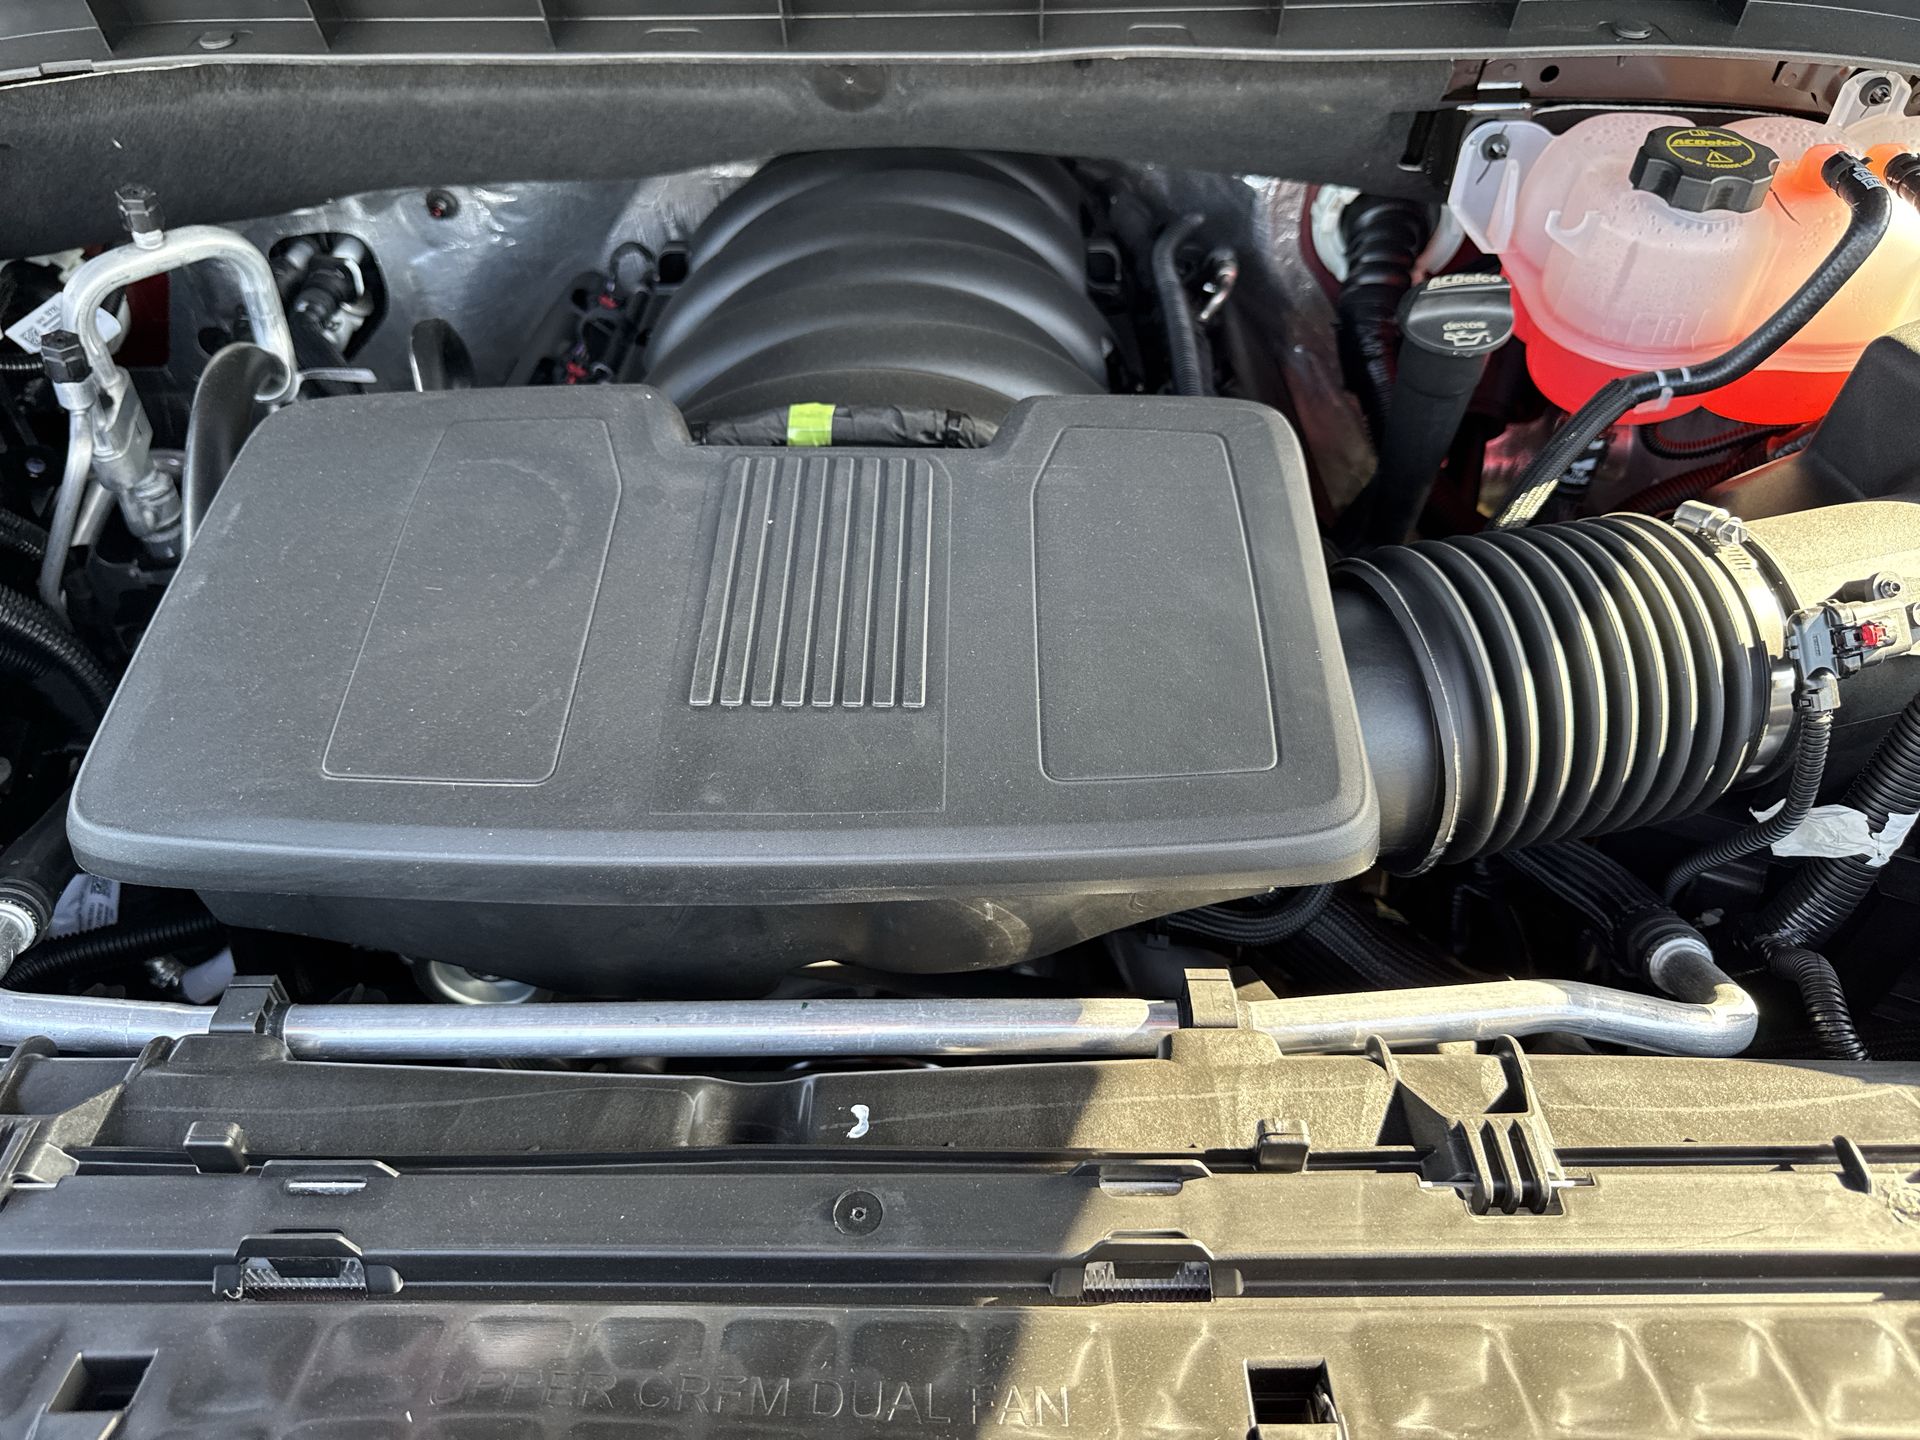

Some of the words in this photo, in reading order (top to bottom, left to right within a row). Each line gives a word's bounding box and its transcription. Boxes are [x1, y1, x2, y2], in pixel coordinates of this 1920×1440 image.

[1670, 138, 1742, 147] ACDelco
[1427, 273, 1502, 290] ACDelco
[1443, 321, 1487, 331] dexos
[429, 1370, 614, 1408] UPPER
[810, 1378, 951, 1424] DUAL
[972, 1384, 1069, 1427] FAN
